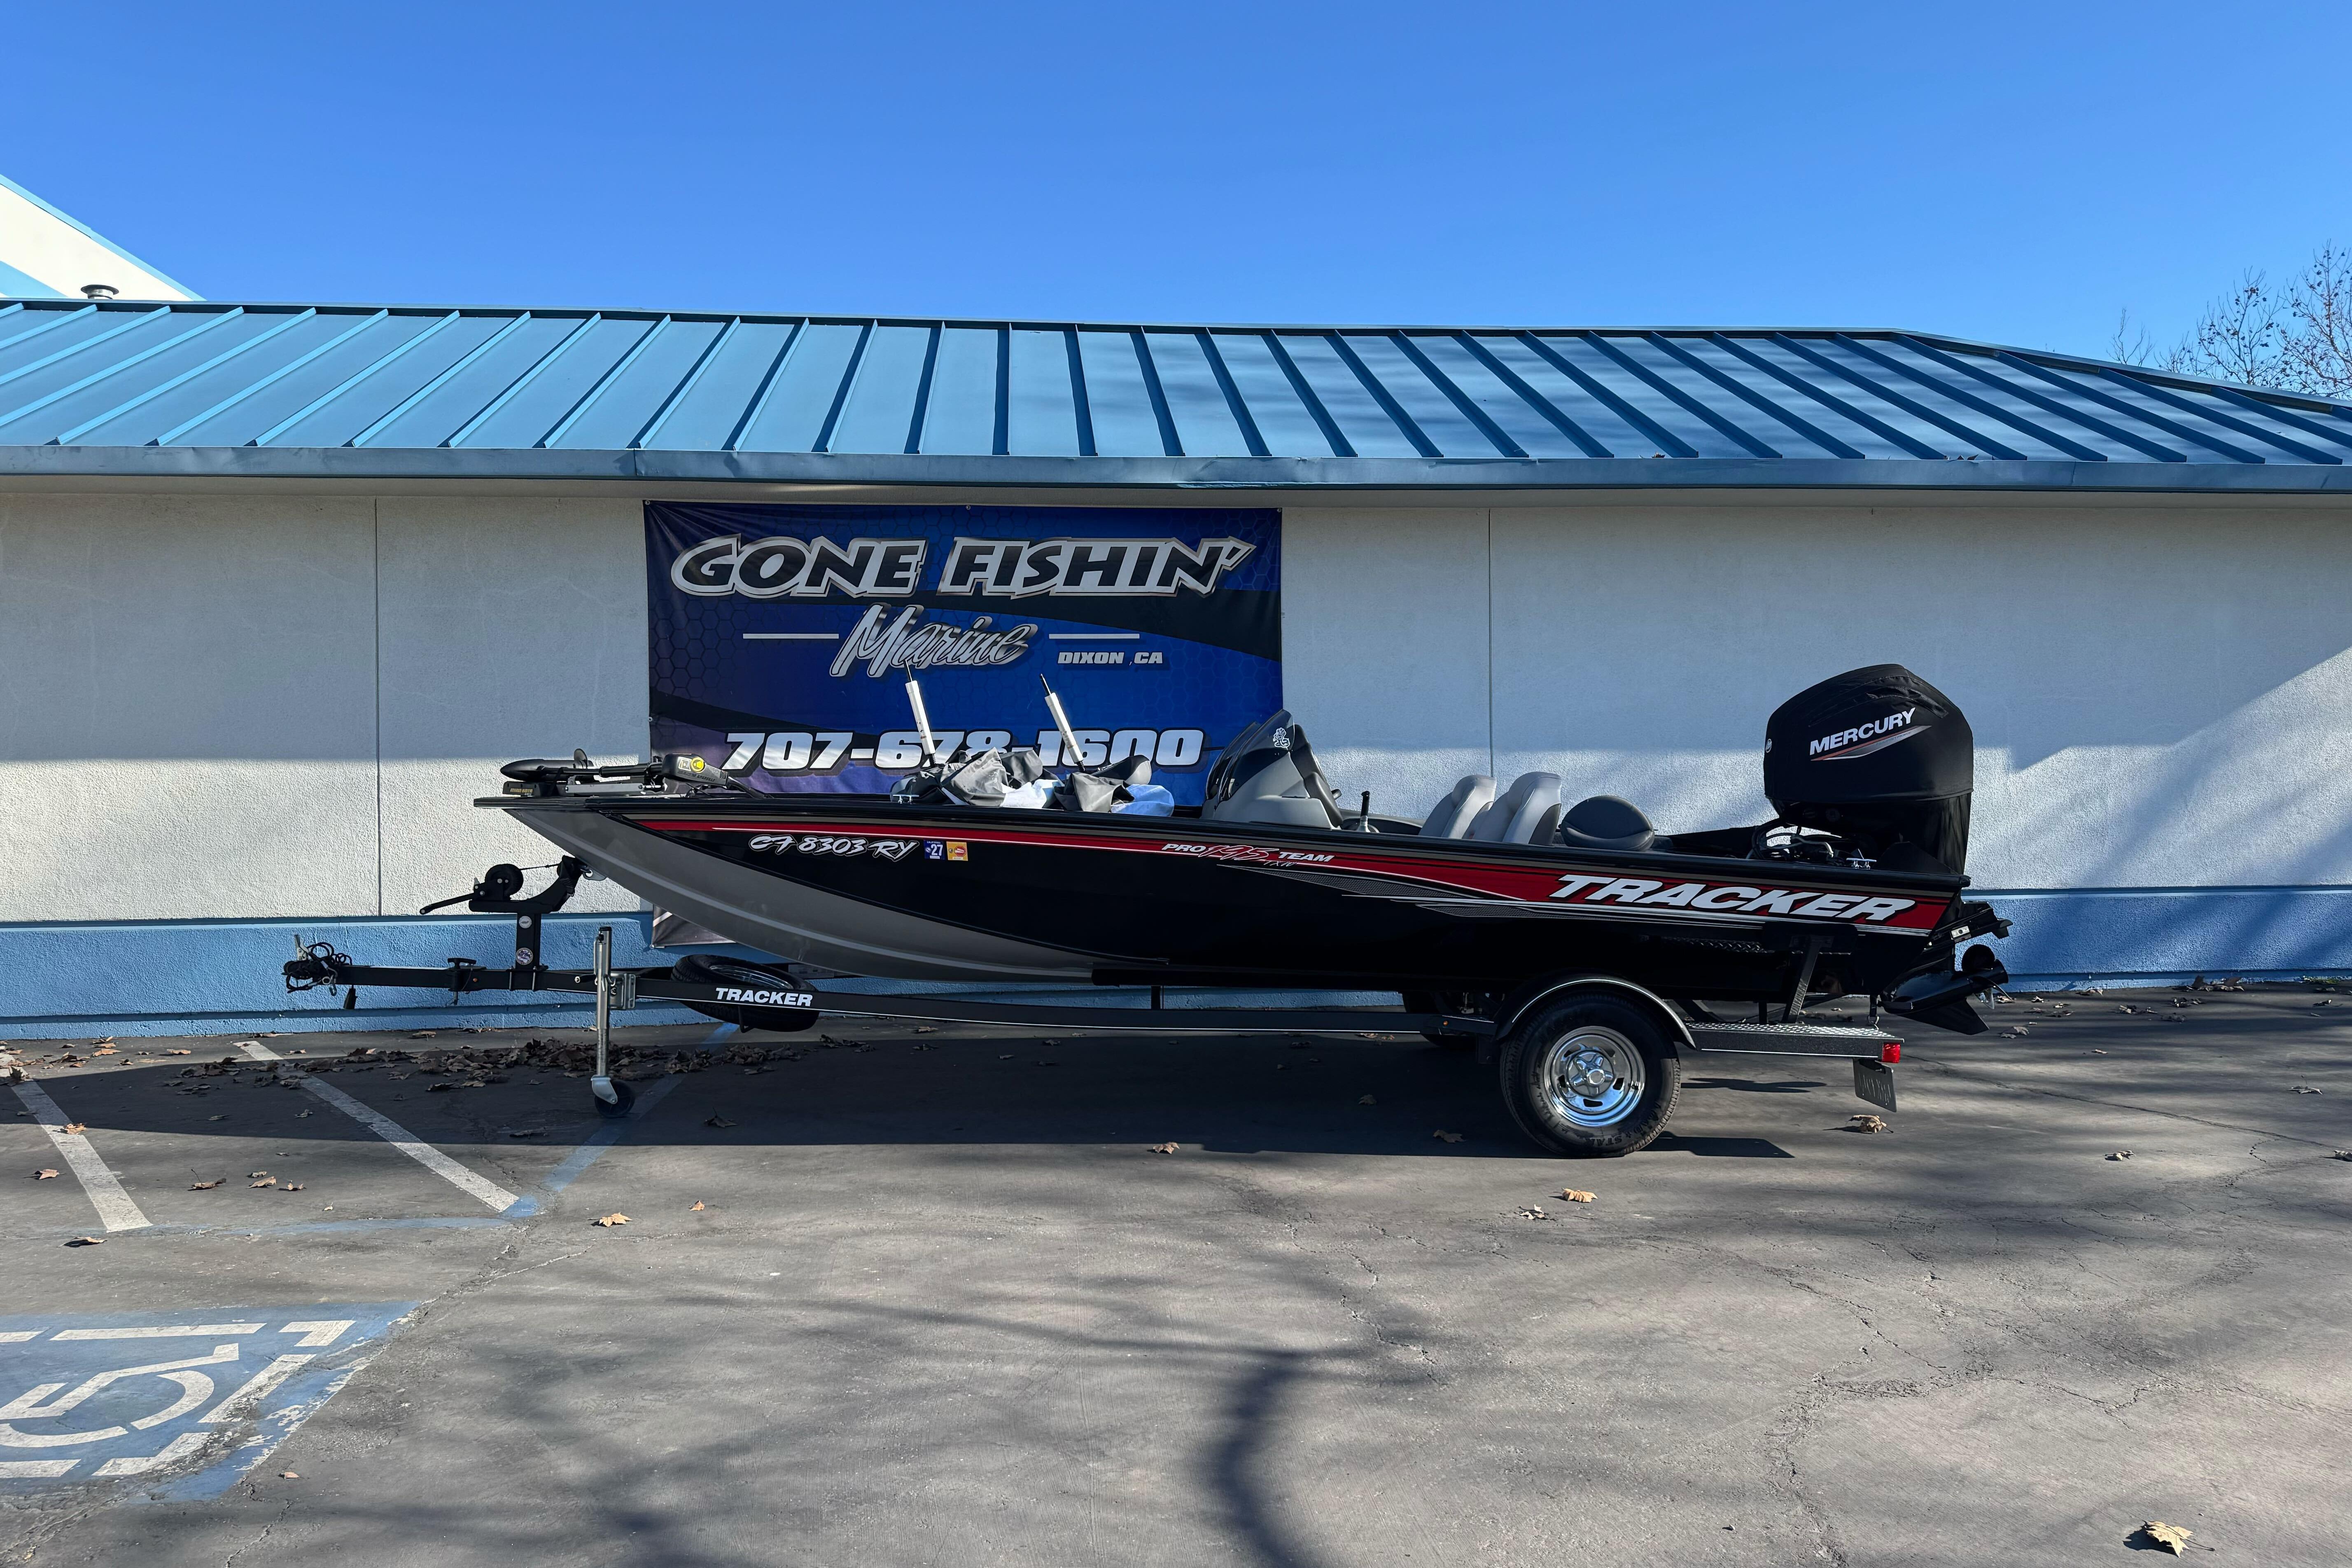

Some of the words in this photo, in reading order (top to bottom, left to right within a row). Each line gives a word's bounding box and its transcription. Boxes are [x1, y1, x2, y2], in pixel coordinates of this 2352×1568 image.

[671, 533, 929, 598] GONE
[936, 536, 1257, 600] FISHIN'
[829, 602, 1038, 677] Marine
[1057, 652, 1125, 664] DIXON
[1809, 707, 1916, 755] MERCURY
[798, 835, 868, 856] 8303
[868, 840, 919, 861] RY
[931, 844, 943, 856] 27
[1162, 843, 1206, 852] PRO
[1198, 845, 1279, 860] 195
[1278, 852, 1335, 862] TEAM
[1549, 874, 1915, 921] TRACKER
[716, 987, 813, 1007] TRACKER
